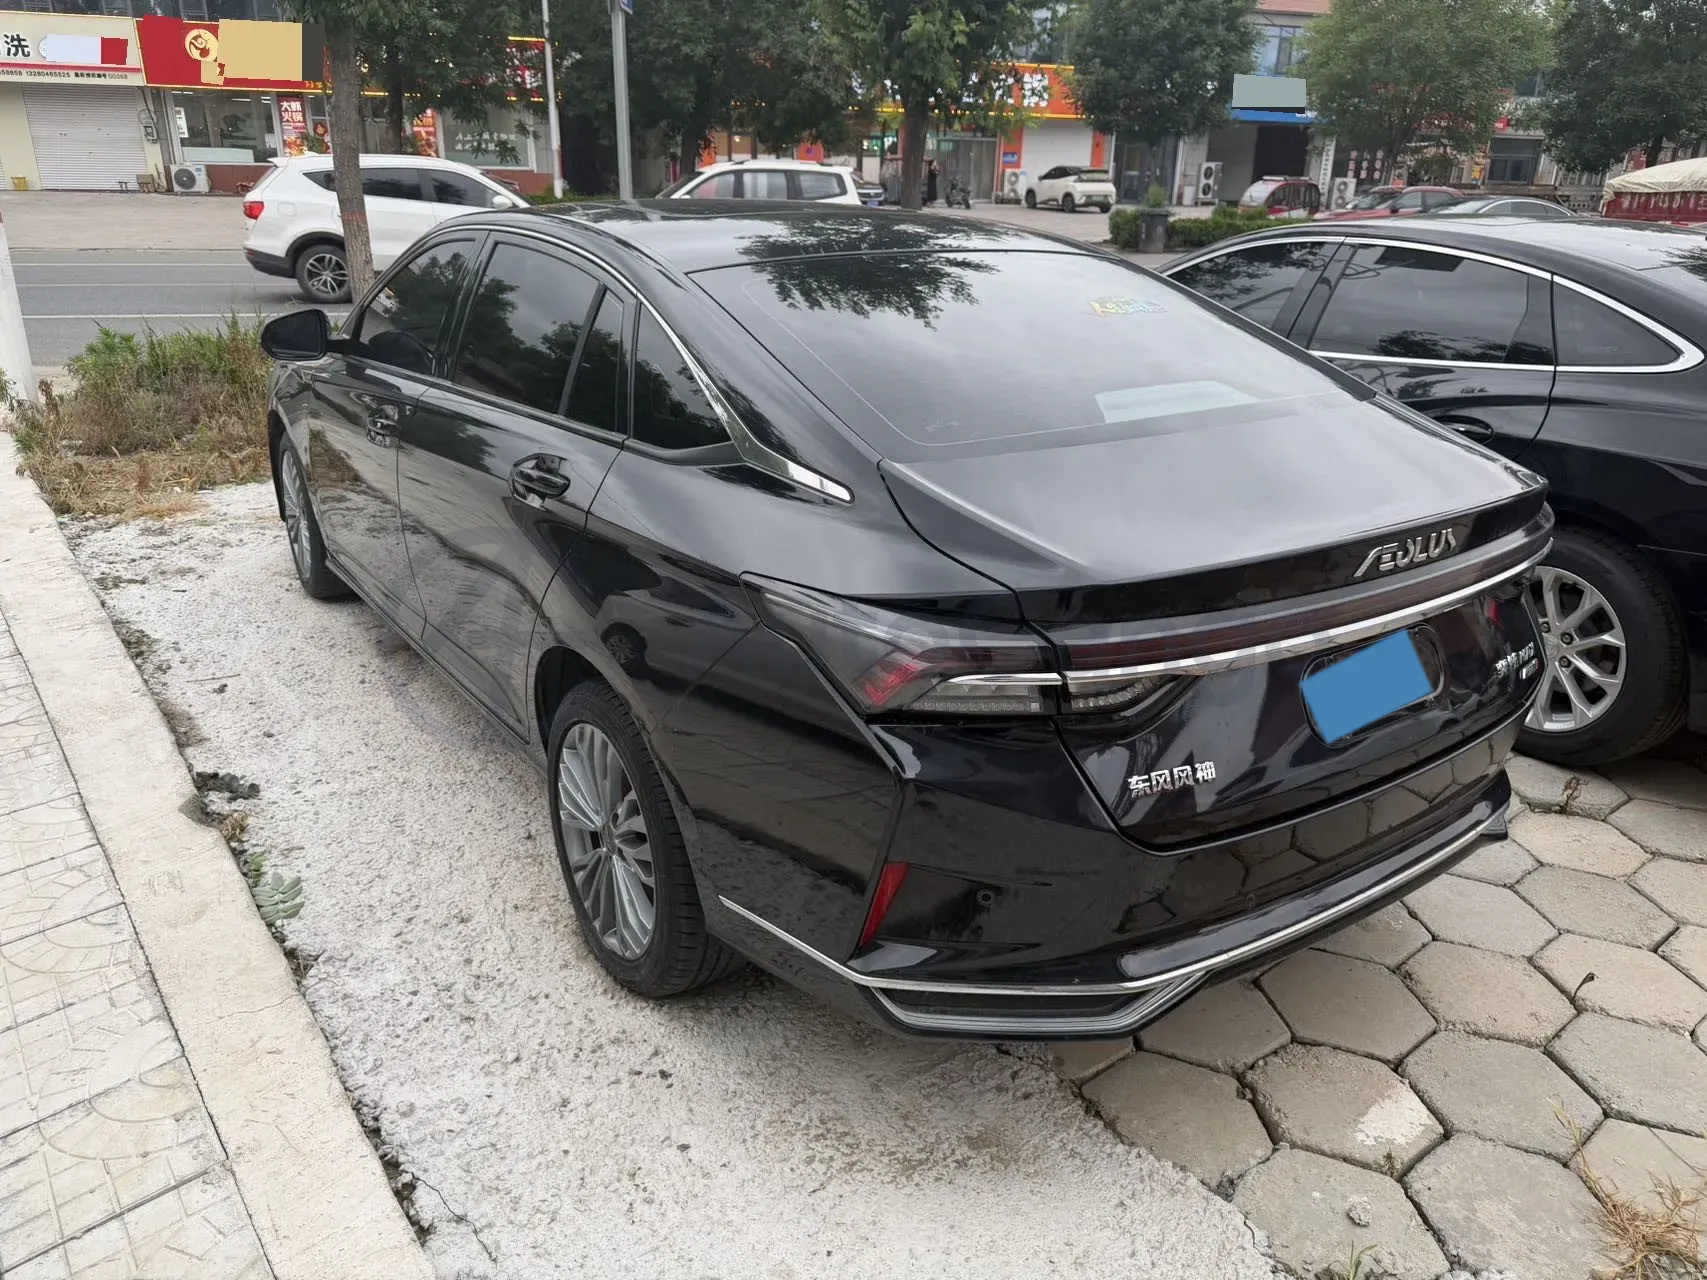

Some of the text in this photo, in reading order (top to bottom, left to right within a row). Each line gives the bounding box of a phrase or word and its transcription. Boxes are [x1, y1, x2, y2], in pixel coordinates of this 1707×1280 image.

[3, 33, 31, 58] 洗
[1353, 527, 1457, 578] AEOLUS
[1127, 760, 1217, 799] 东风风神
